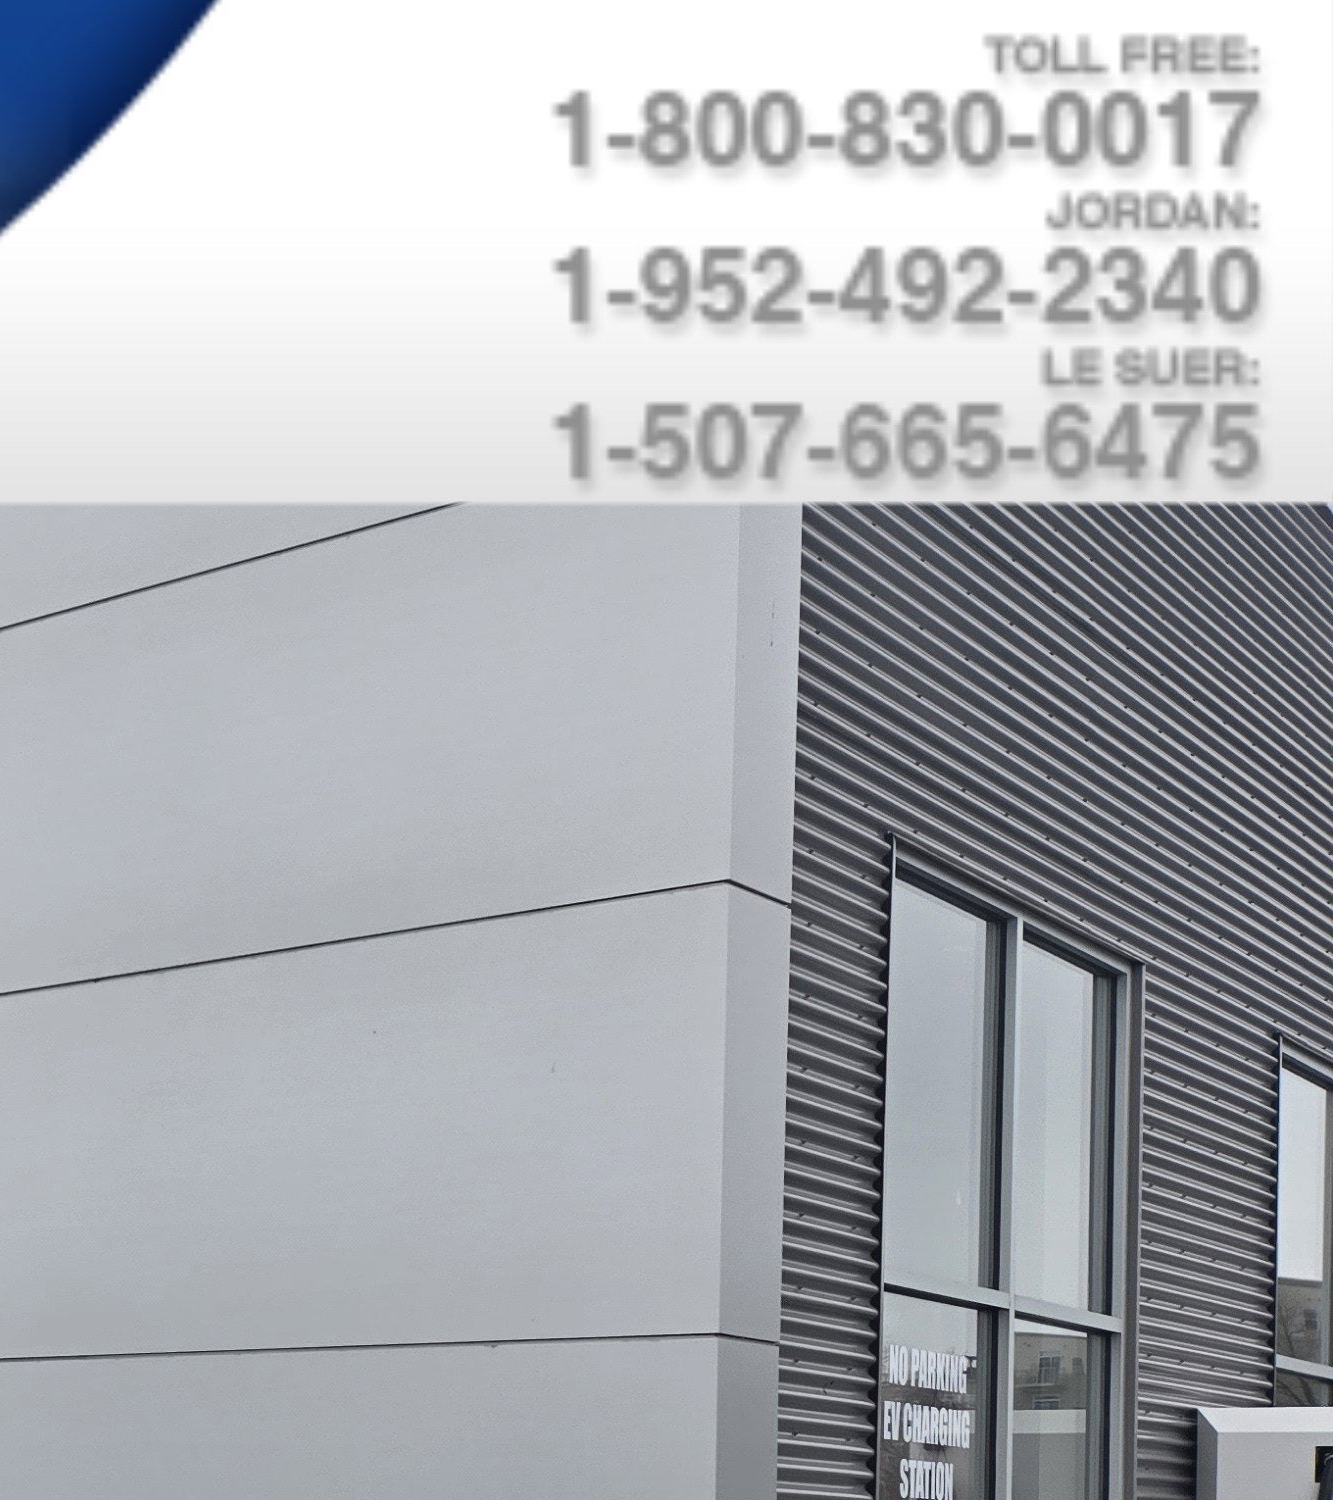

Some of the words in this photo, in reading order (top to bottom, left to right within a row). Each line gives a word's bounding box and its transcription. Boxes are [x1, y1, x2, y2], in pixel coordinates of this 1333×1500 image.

[889, 1344, 909, 1387] NO
[910, 1347, 968, 1395] PARKING
[883, 1400, 902, 1441] EV
[902, 1402, 971, 1449] CHARGING
